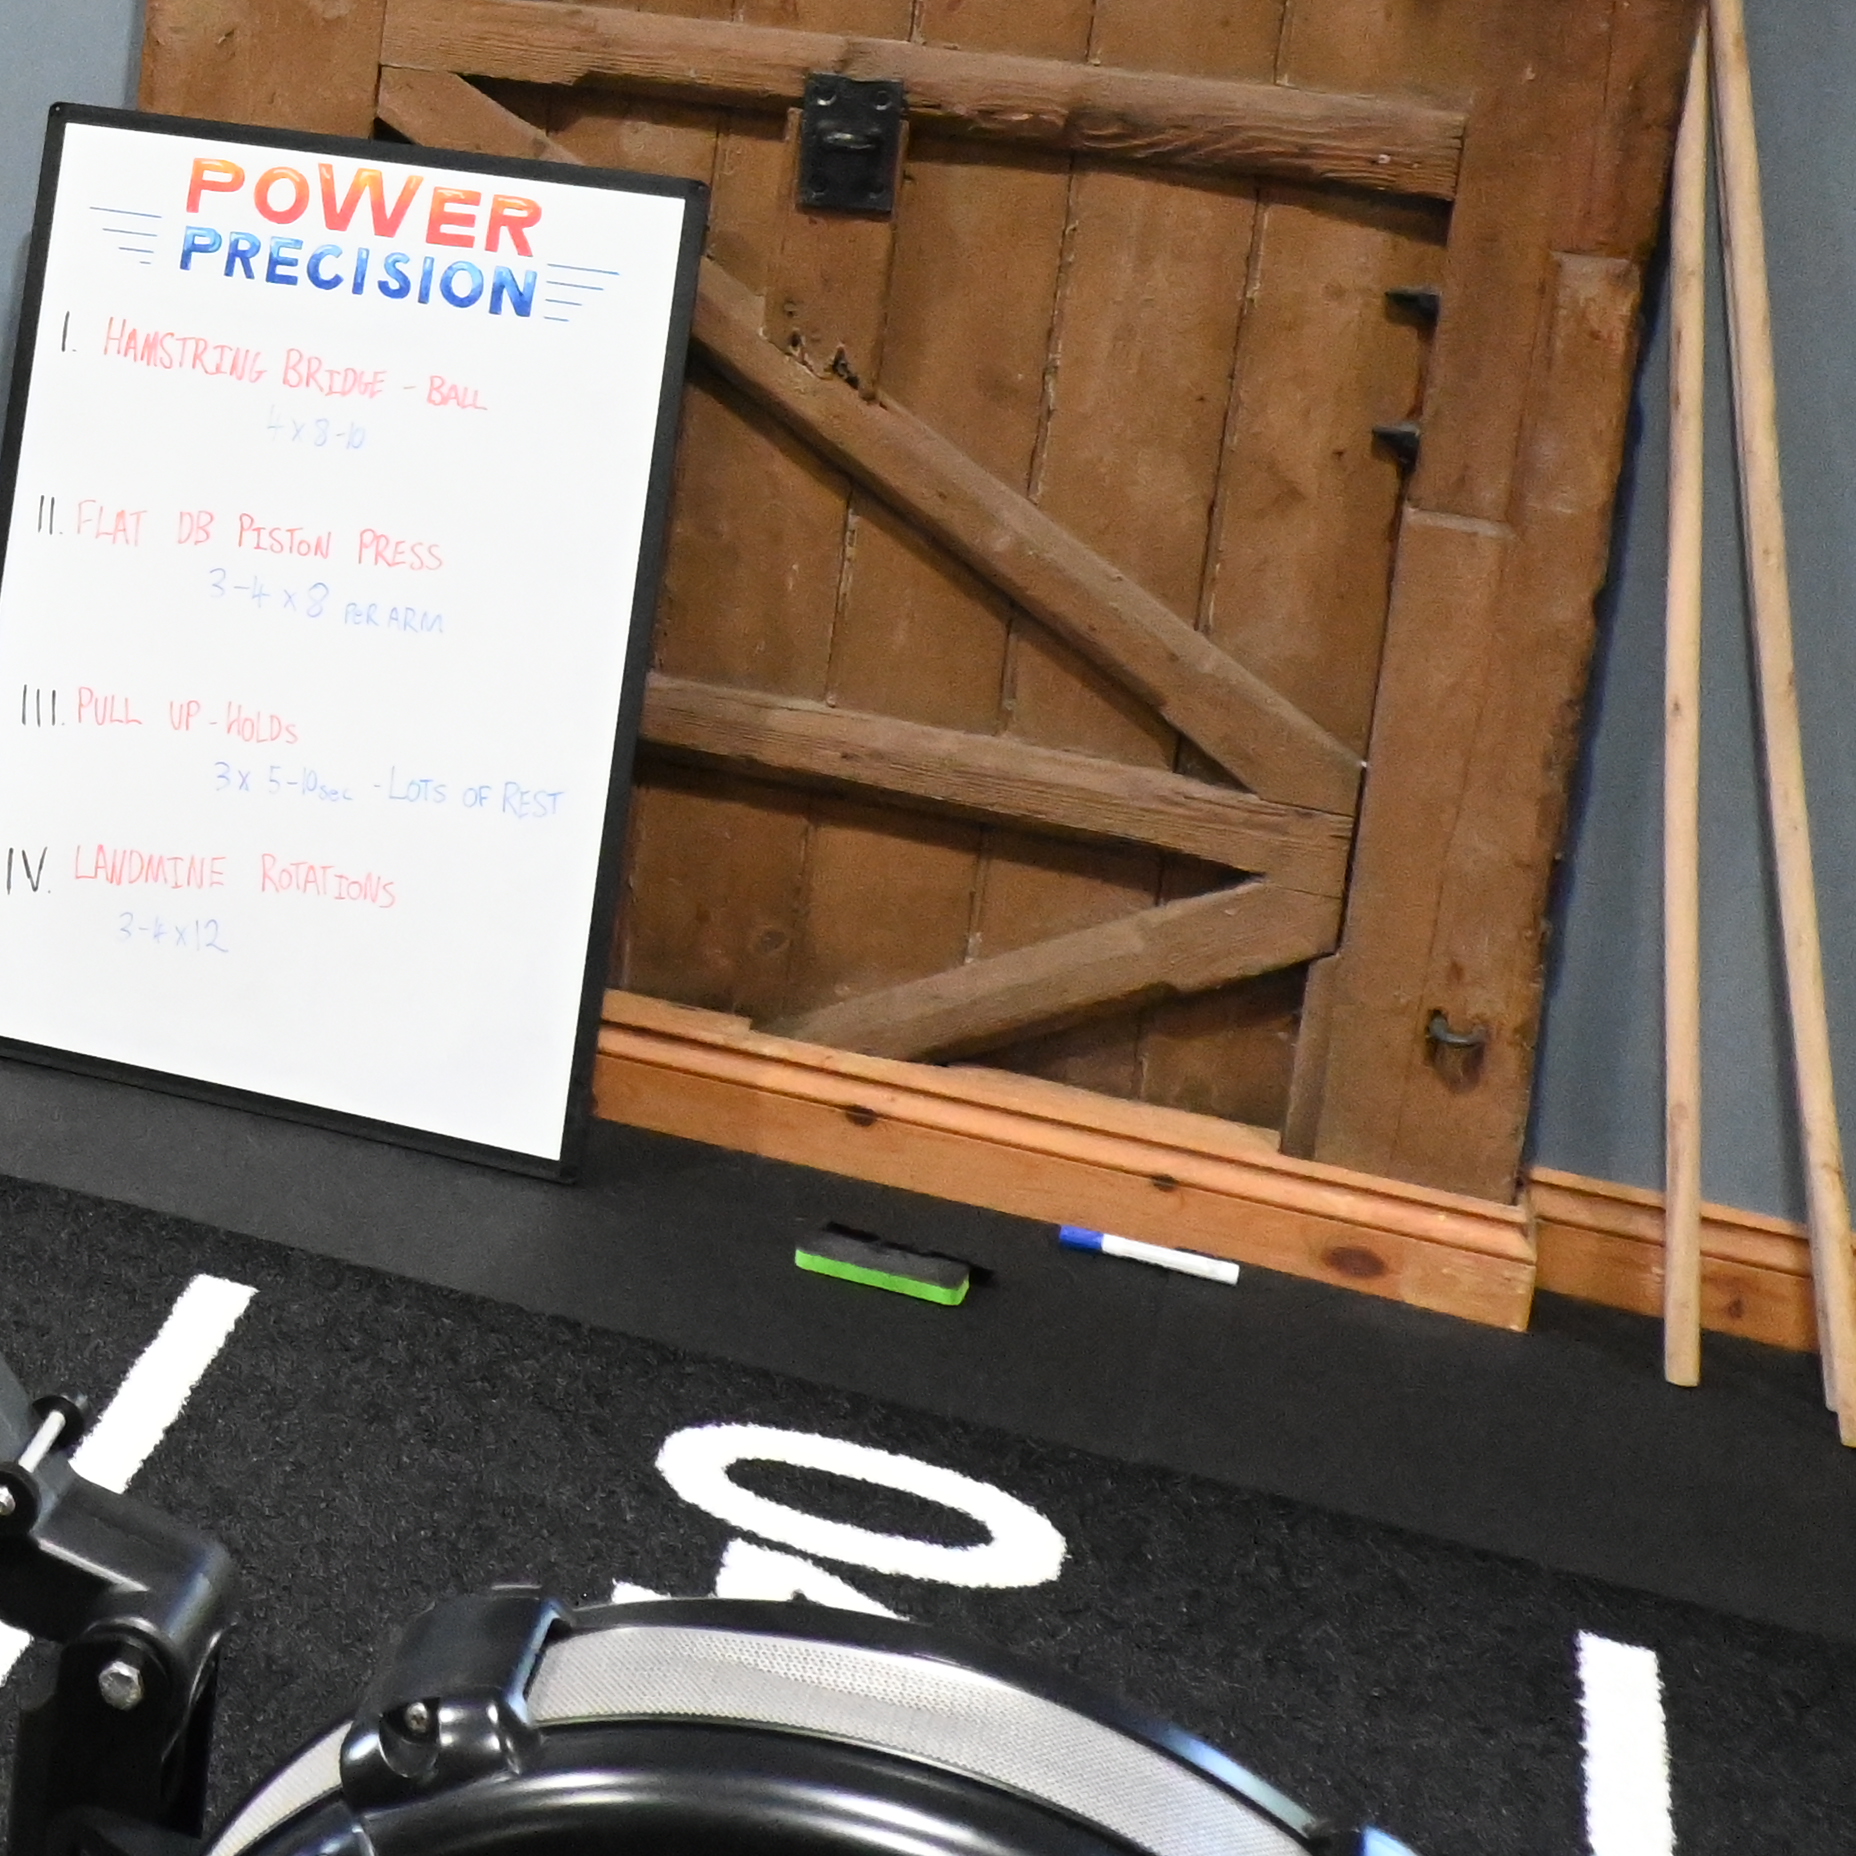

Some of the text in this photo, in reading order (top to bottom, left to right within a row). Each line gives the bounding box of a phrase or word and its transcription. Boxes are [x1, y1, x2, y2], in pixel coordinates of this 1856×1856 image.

[185, 157, 543, 257] POWER
[179, 226, 538, 318] PRECISION
[104, 317, 267, 383] HAMSTRING
[281, 347, 387, 399] BRIDGE
[426, 374, 488, 411] BALL
[76, 499, 148, 547] FLAT
[177, 510, 215, 546] DB
[237, 512, 333, 560] PISTON
[357, 527, 444, 571] PRESS
[208, 567, 271, 608] 3-4
[387, 605, 444, 634] ARM
[77, 685, 143, 727] PULL
[462, 784, 492, 809] OF
[501, 780, 564, 819] REST
[74, 843, 227, 890] LANDMINE
[260, 852, 396, 909] ROTATIONS
